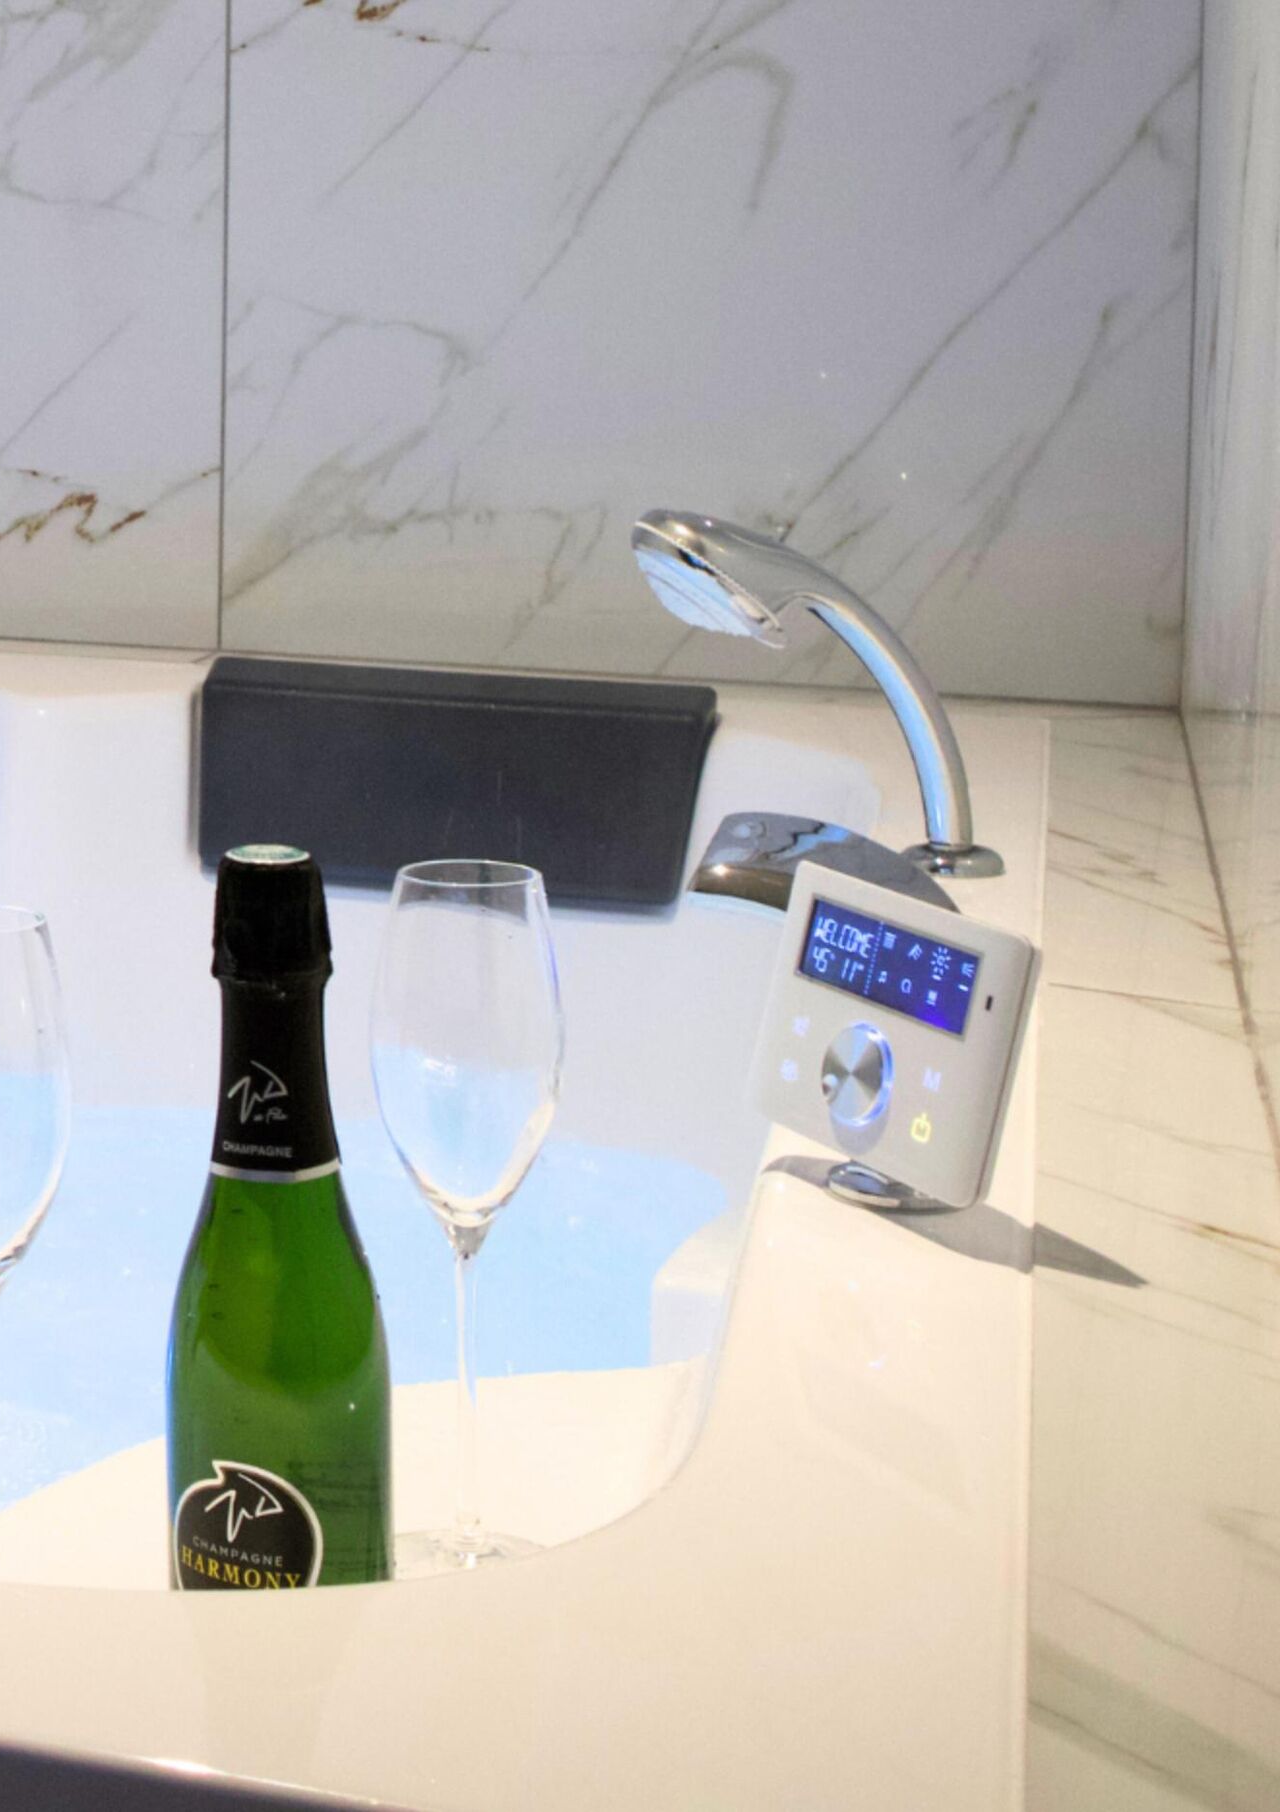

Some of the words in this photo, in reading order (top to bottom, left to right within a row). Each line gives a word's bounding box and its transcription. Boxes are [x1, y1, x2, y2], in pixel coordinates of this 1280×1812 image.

[814, 917, 875, 959] WELCOME
[222, 1140, 294, 1158] CHAMPAGNE
[180, 1544, 302, 1590] HARMONY
[192, 1535, 285, 1567] CHAMPAGNE
